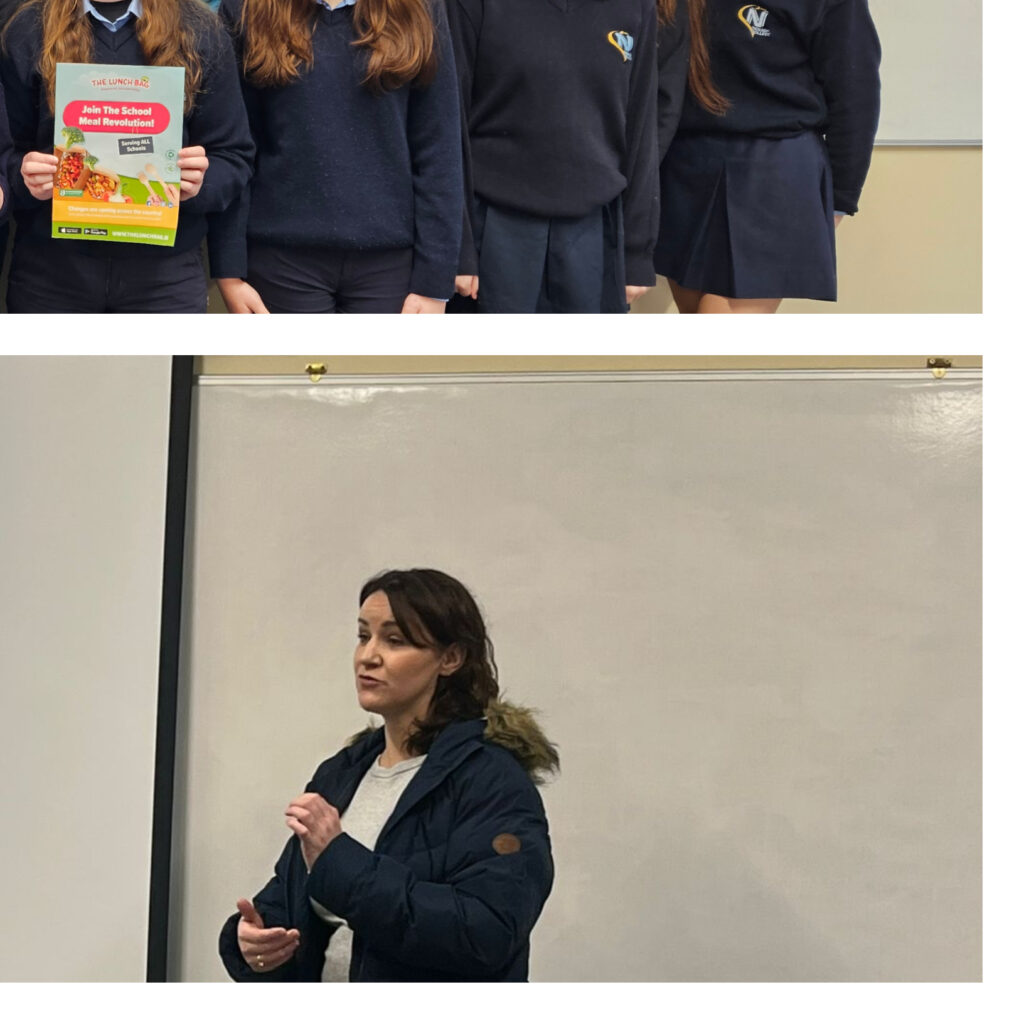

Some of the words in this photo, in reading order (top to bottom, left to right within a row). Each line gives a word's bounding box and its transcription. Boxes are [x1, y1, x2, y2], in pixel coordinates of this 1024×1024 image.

[134, 79, 150, 88] BAG
[81, 105, 101, 114] Join
[103, 105, 120, 115] The
[121, 106, 152, 116] School
[78, 117, 101, 126] Meal
[102, 117, 155, 128] Revolution!
